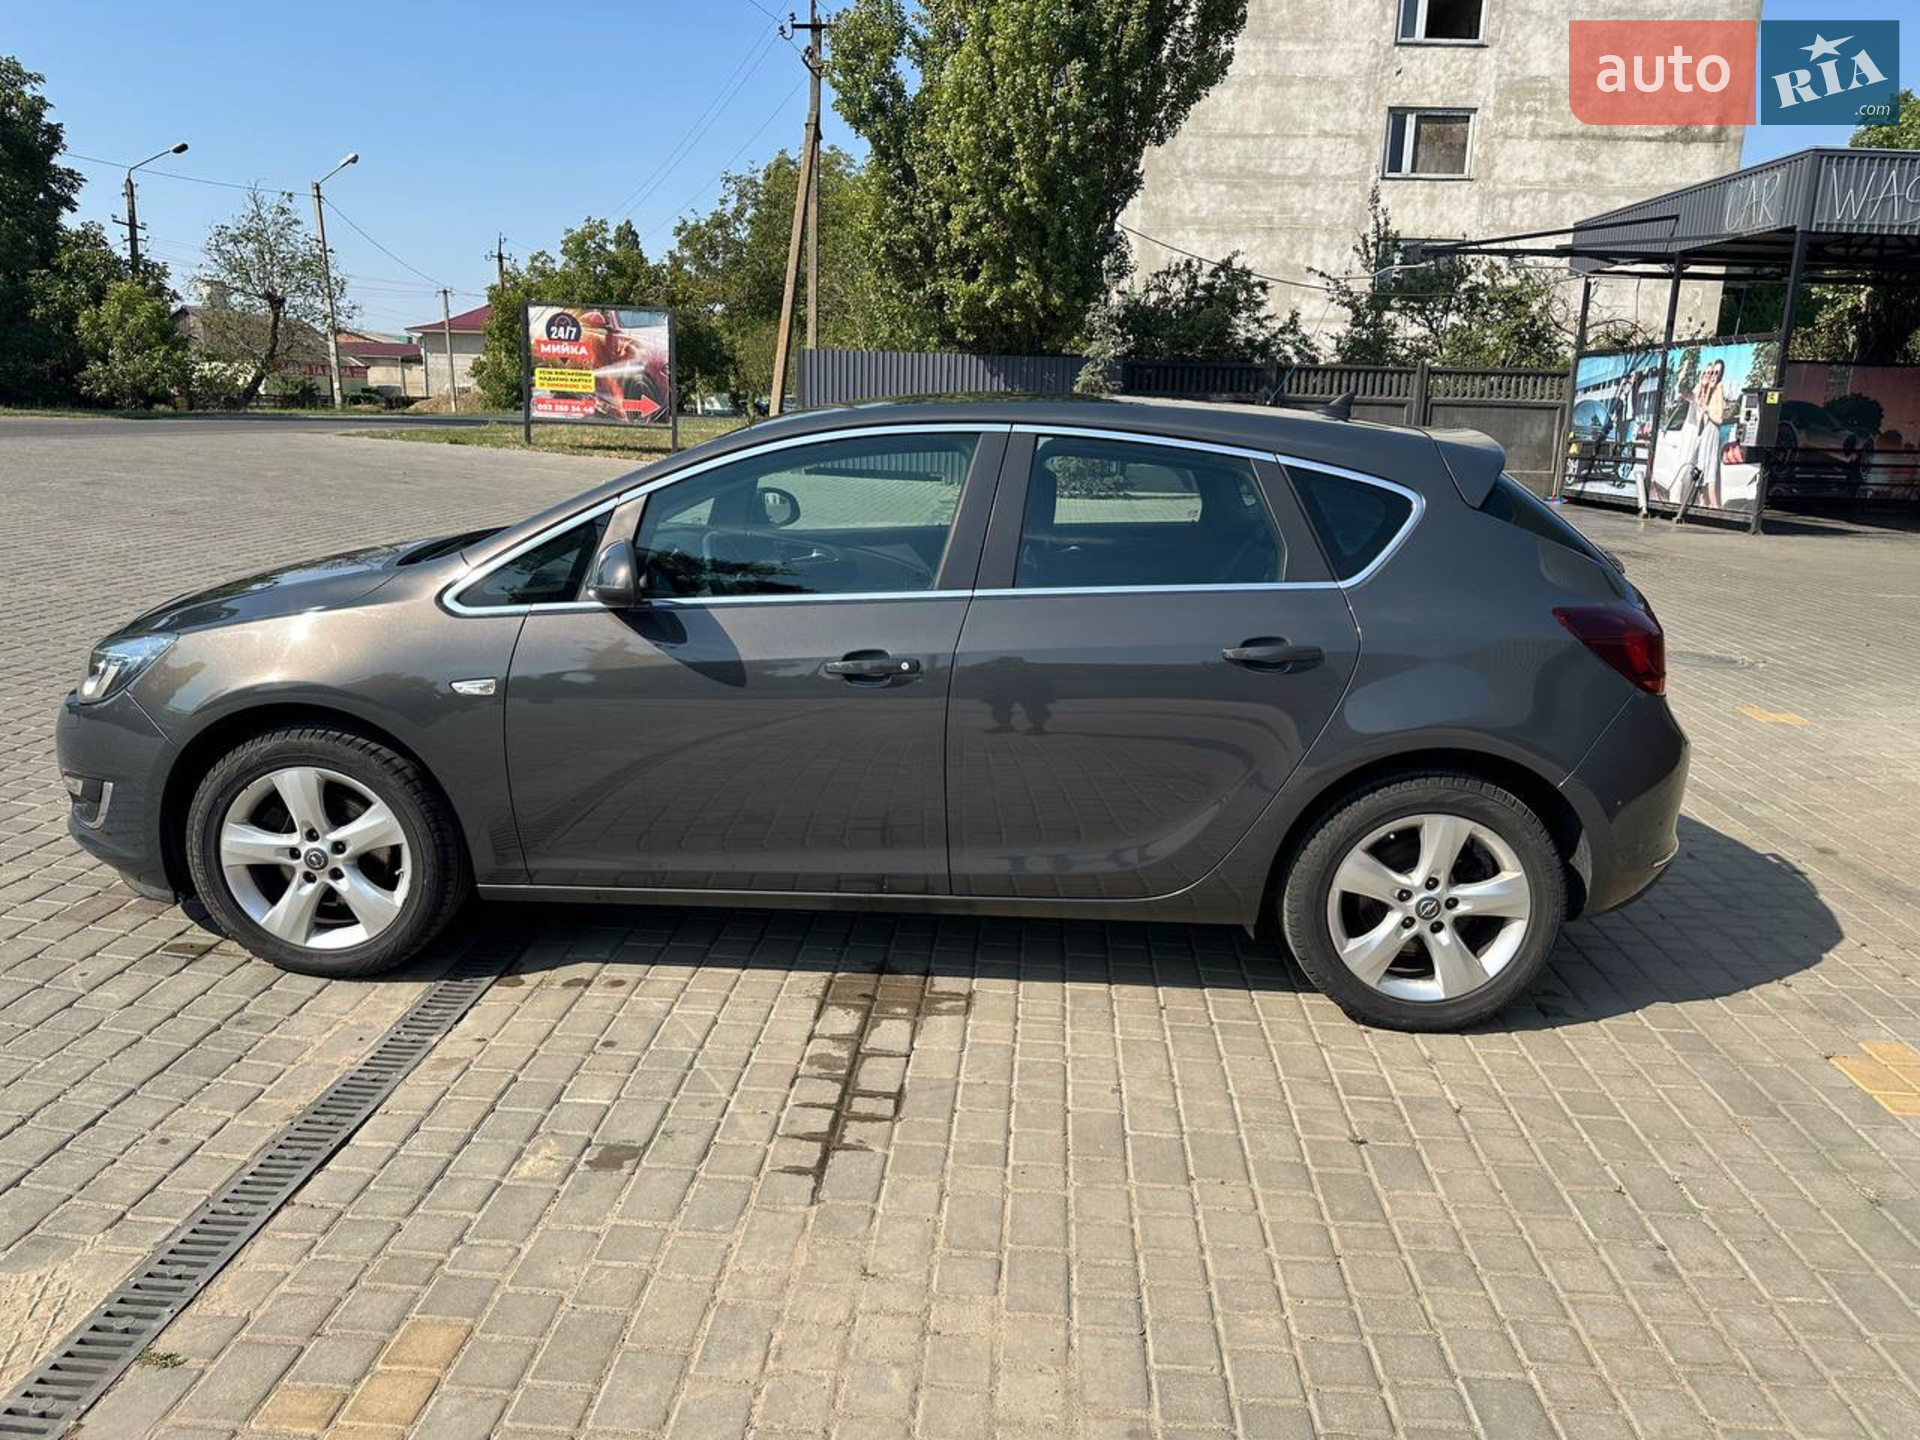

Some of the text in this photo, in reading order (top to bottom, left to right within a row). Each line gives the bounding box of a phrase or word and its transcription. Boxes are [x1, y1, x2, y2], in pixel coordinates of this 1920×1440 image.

[1725, 173, 1780, 231] CAR
[551, 326, 577, 339] 24/7
[541, 343, 588, 355] МИЙКА
